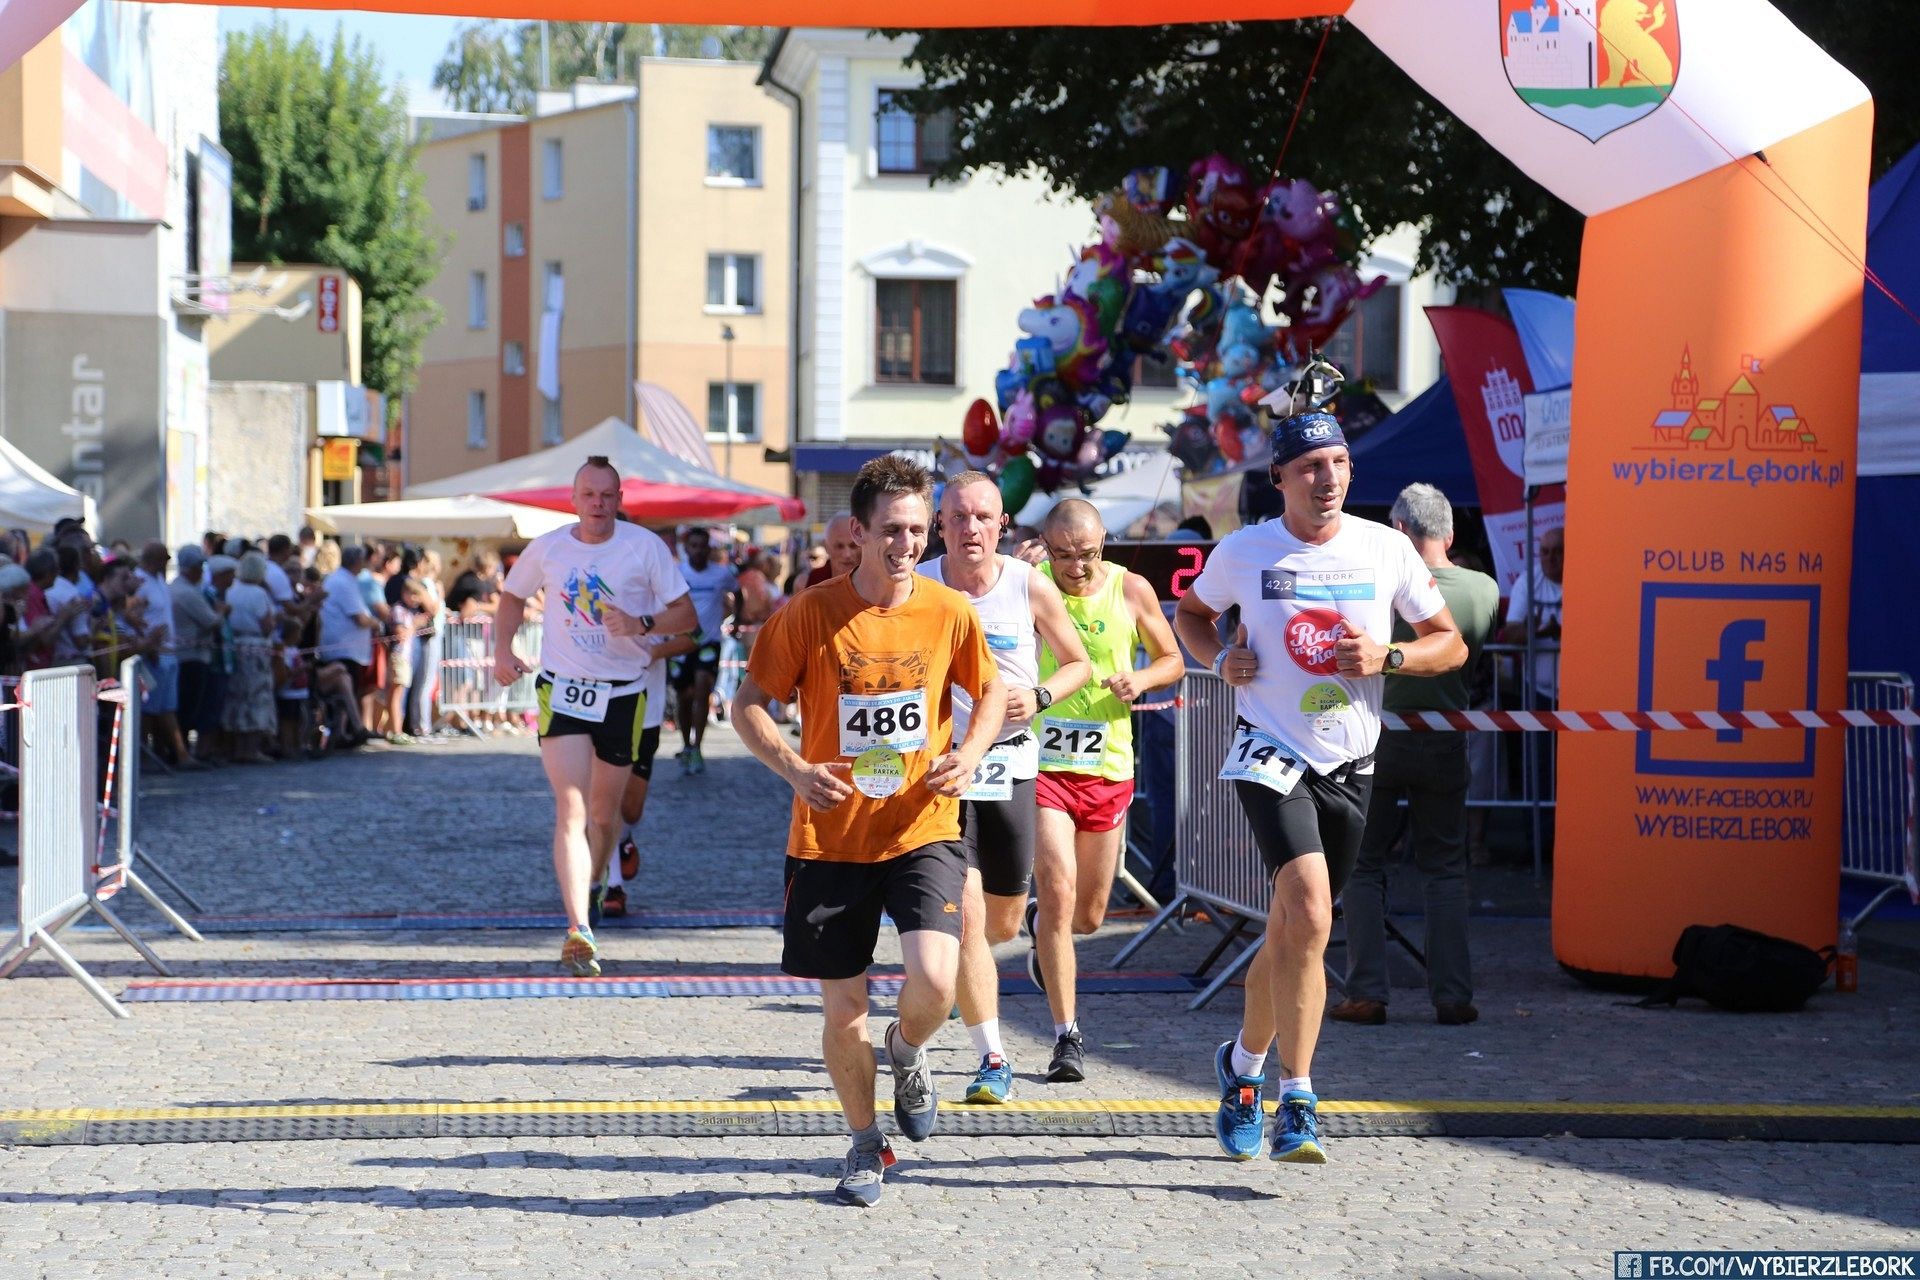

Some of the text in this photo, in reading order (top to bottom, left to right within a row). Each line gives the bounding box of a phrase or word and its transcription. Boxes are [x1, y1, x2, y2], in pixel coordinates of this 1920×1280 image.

[1612, 457, 1845, 488] wybierzLębork.pl
[1643, 549, 1823, 573] POLUB NAS NA
[1265, 580, 1292, 591] 42,2
[1311, 572, 1354, 582] LĘBORK
[1290, 622, 1346, 647] Rak
[564, 686, 597, 707] 90
[846, 703, 921, 737] 486
[1044, 727, 1103, 753] 212
[1238, 738, 1297, 777] 141
[1634, 813, 1813, 841] WYBIERZLEBORK
[702, 1116, 757, 1124] adam hall
